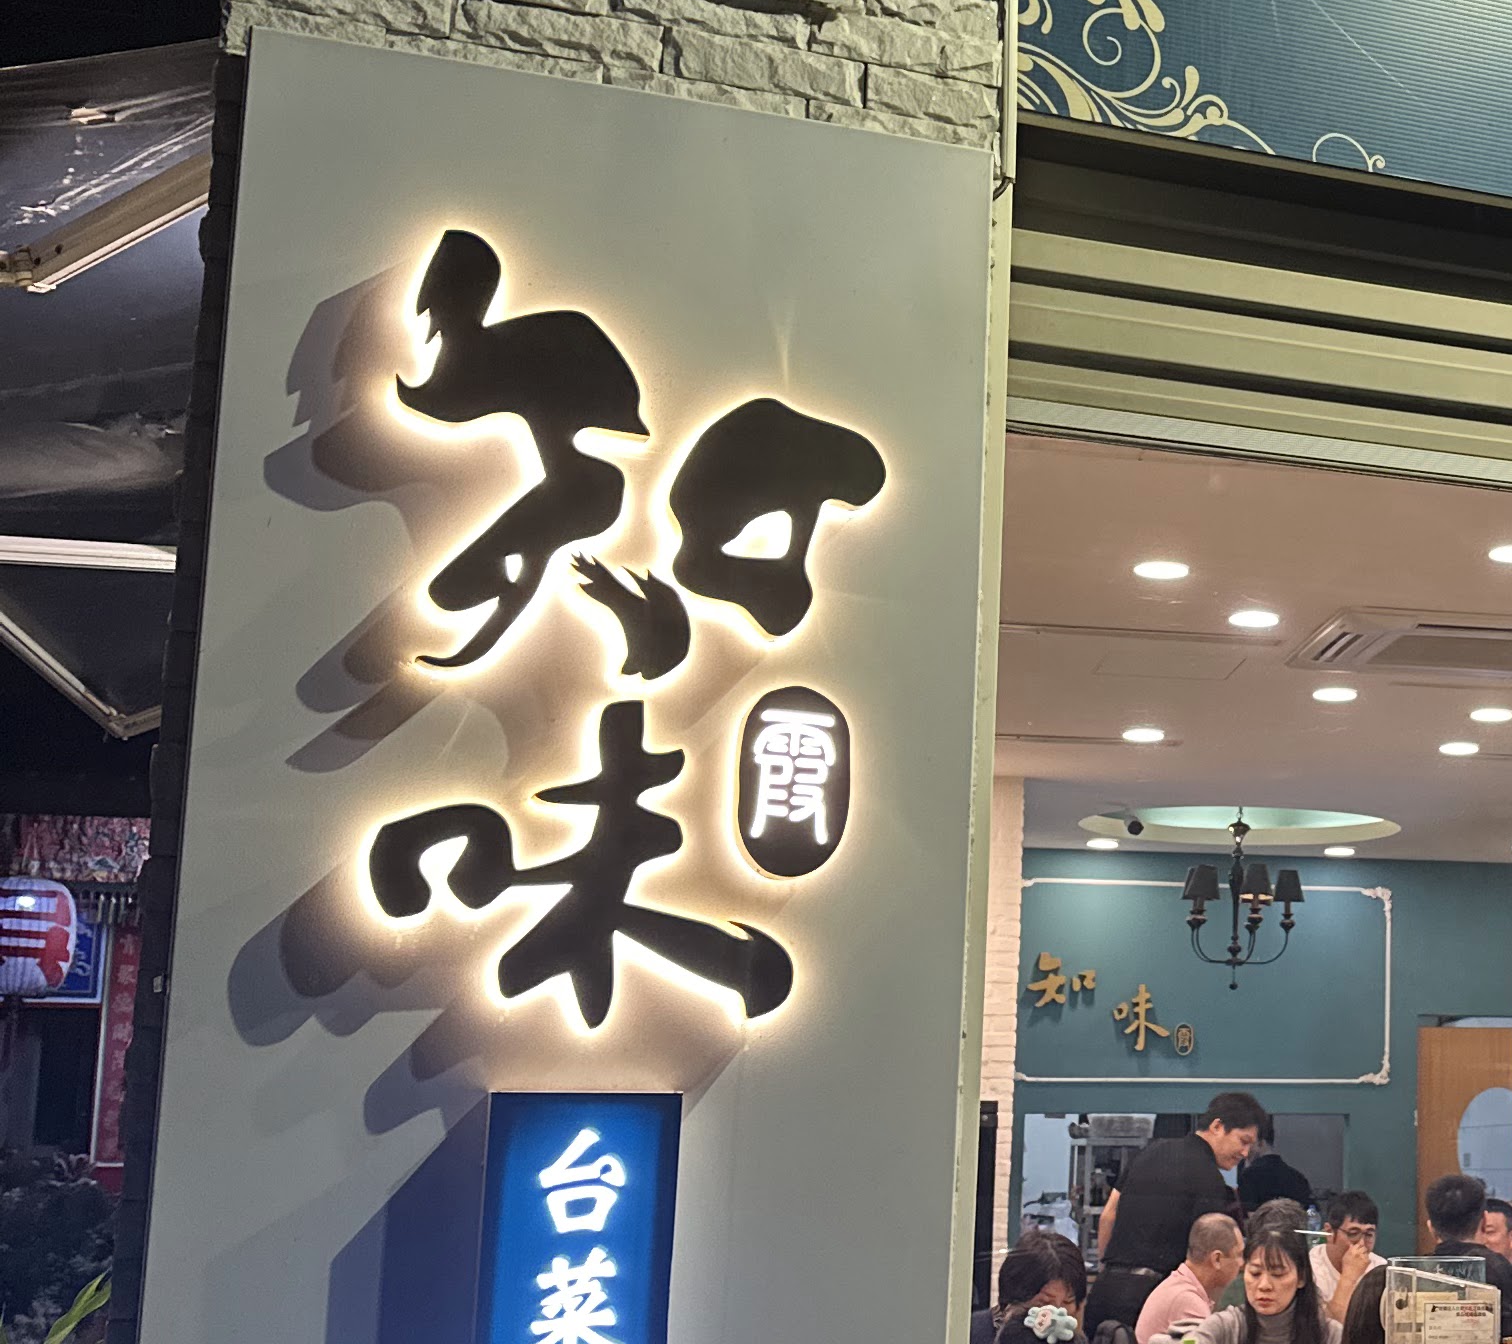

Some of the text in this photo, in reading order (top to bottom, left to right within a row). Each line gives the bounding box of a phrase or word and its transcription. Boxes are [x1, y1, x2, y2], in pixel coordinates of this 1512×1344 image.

[368, 228, 888, 1030] 知味
[750, 707, 837, 845] 霞
[1026, 951, 1171, 1051] 知味
